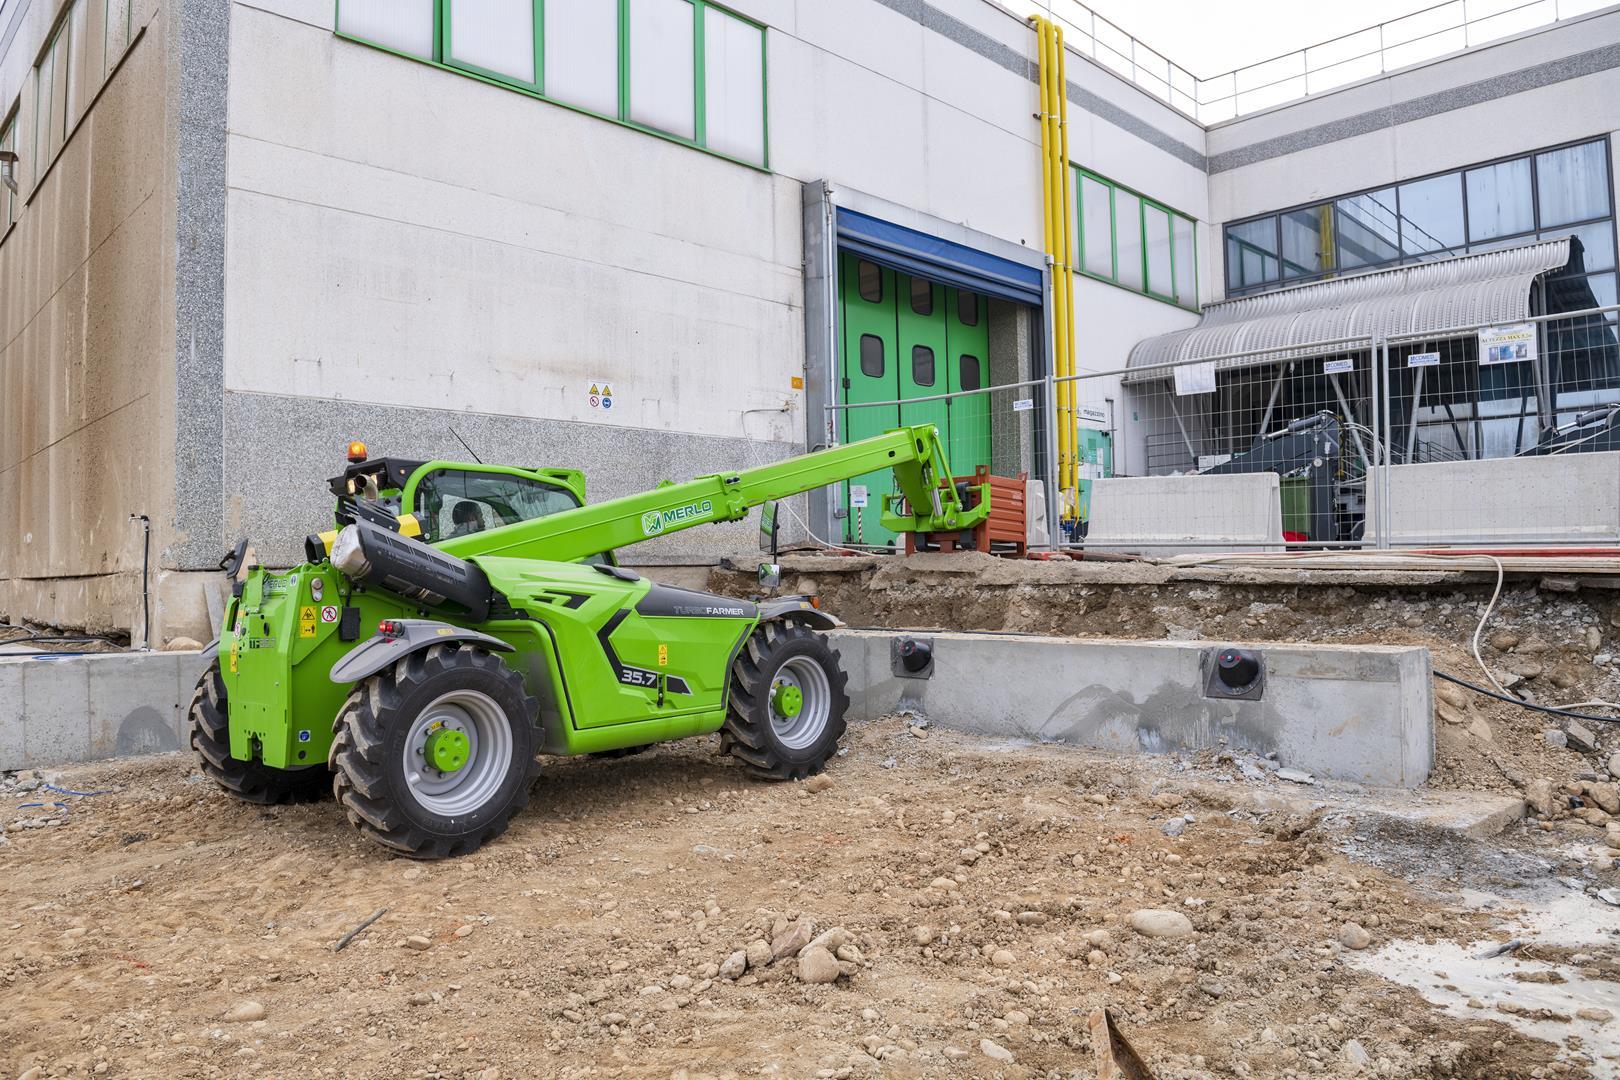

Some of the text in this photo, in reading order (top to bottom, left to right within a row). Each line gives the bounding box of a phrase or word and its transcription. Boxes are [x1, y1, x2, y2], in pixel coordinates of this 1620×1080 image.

[1507, 332, 1521, 340] MAX
[1083, 408, 1105, 418] magazzino
[663, 500, 713, 523] MERLO
[621, 669, 657, 686] 35.7
